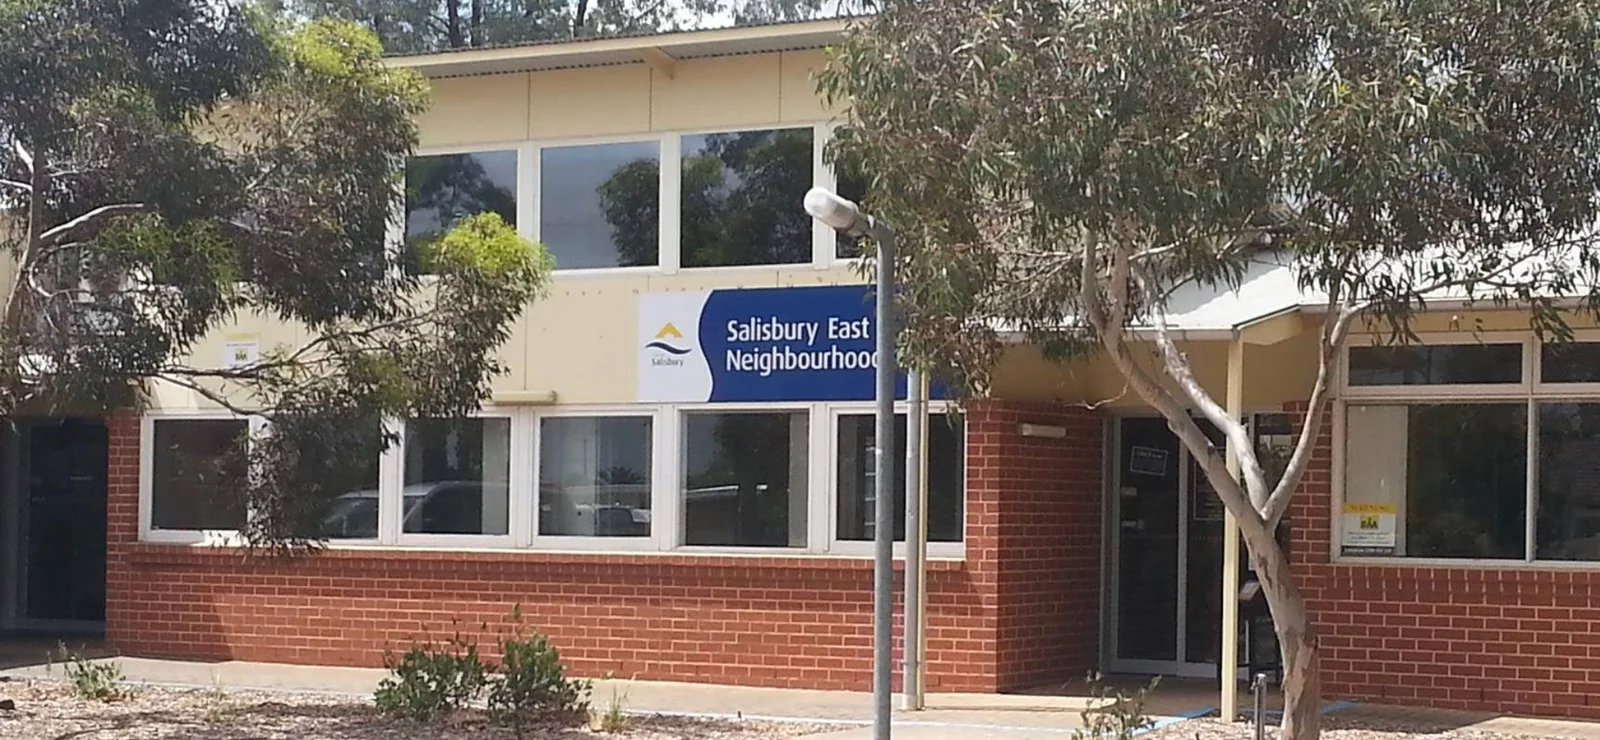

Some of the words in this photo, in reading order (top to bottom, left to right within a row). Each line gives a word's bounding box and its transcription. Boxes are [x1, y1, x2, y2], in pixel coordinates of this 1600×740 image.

[727, 316, 819, 346] Salisbury
[828, 317, 870, 339] East
[651, 357, 684, 368] Salisbury
